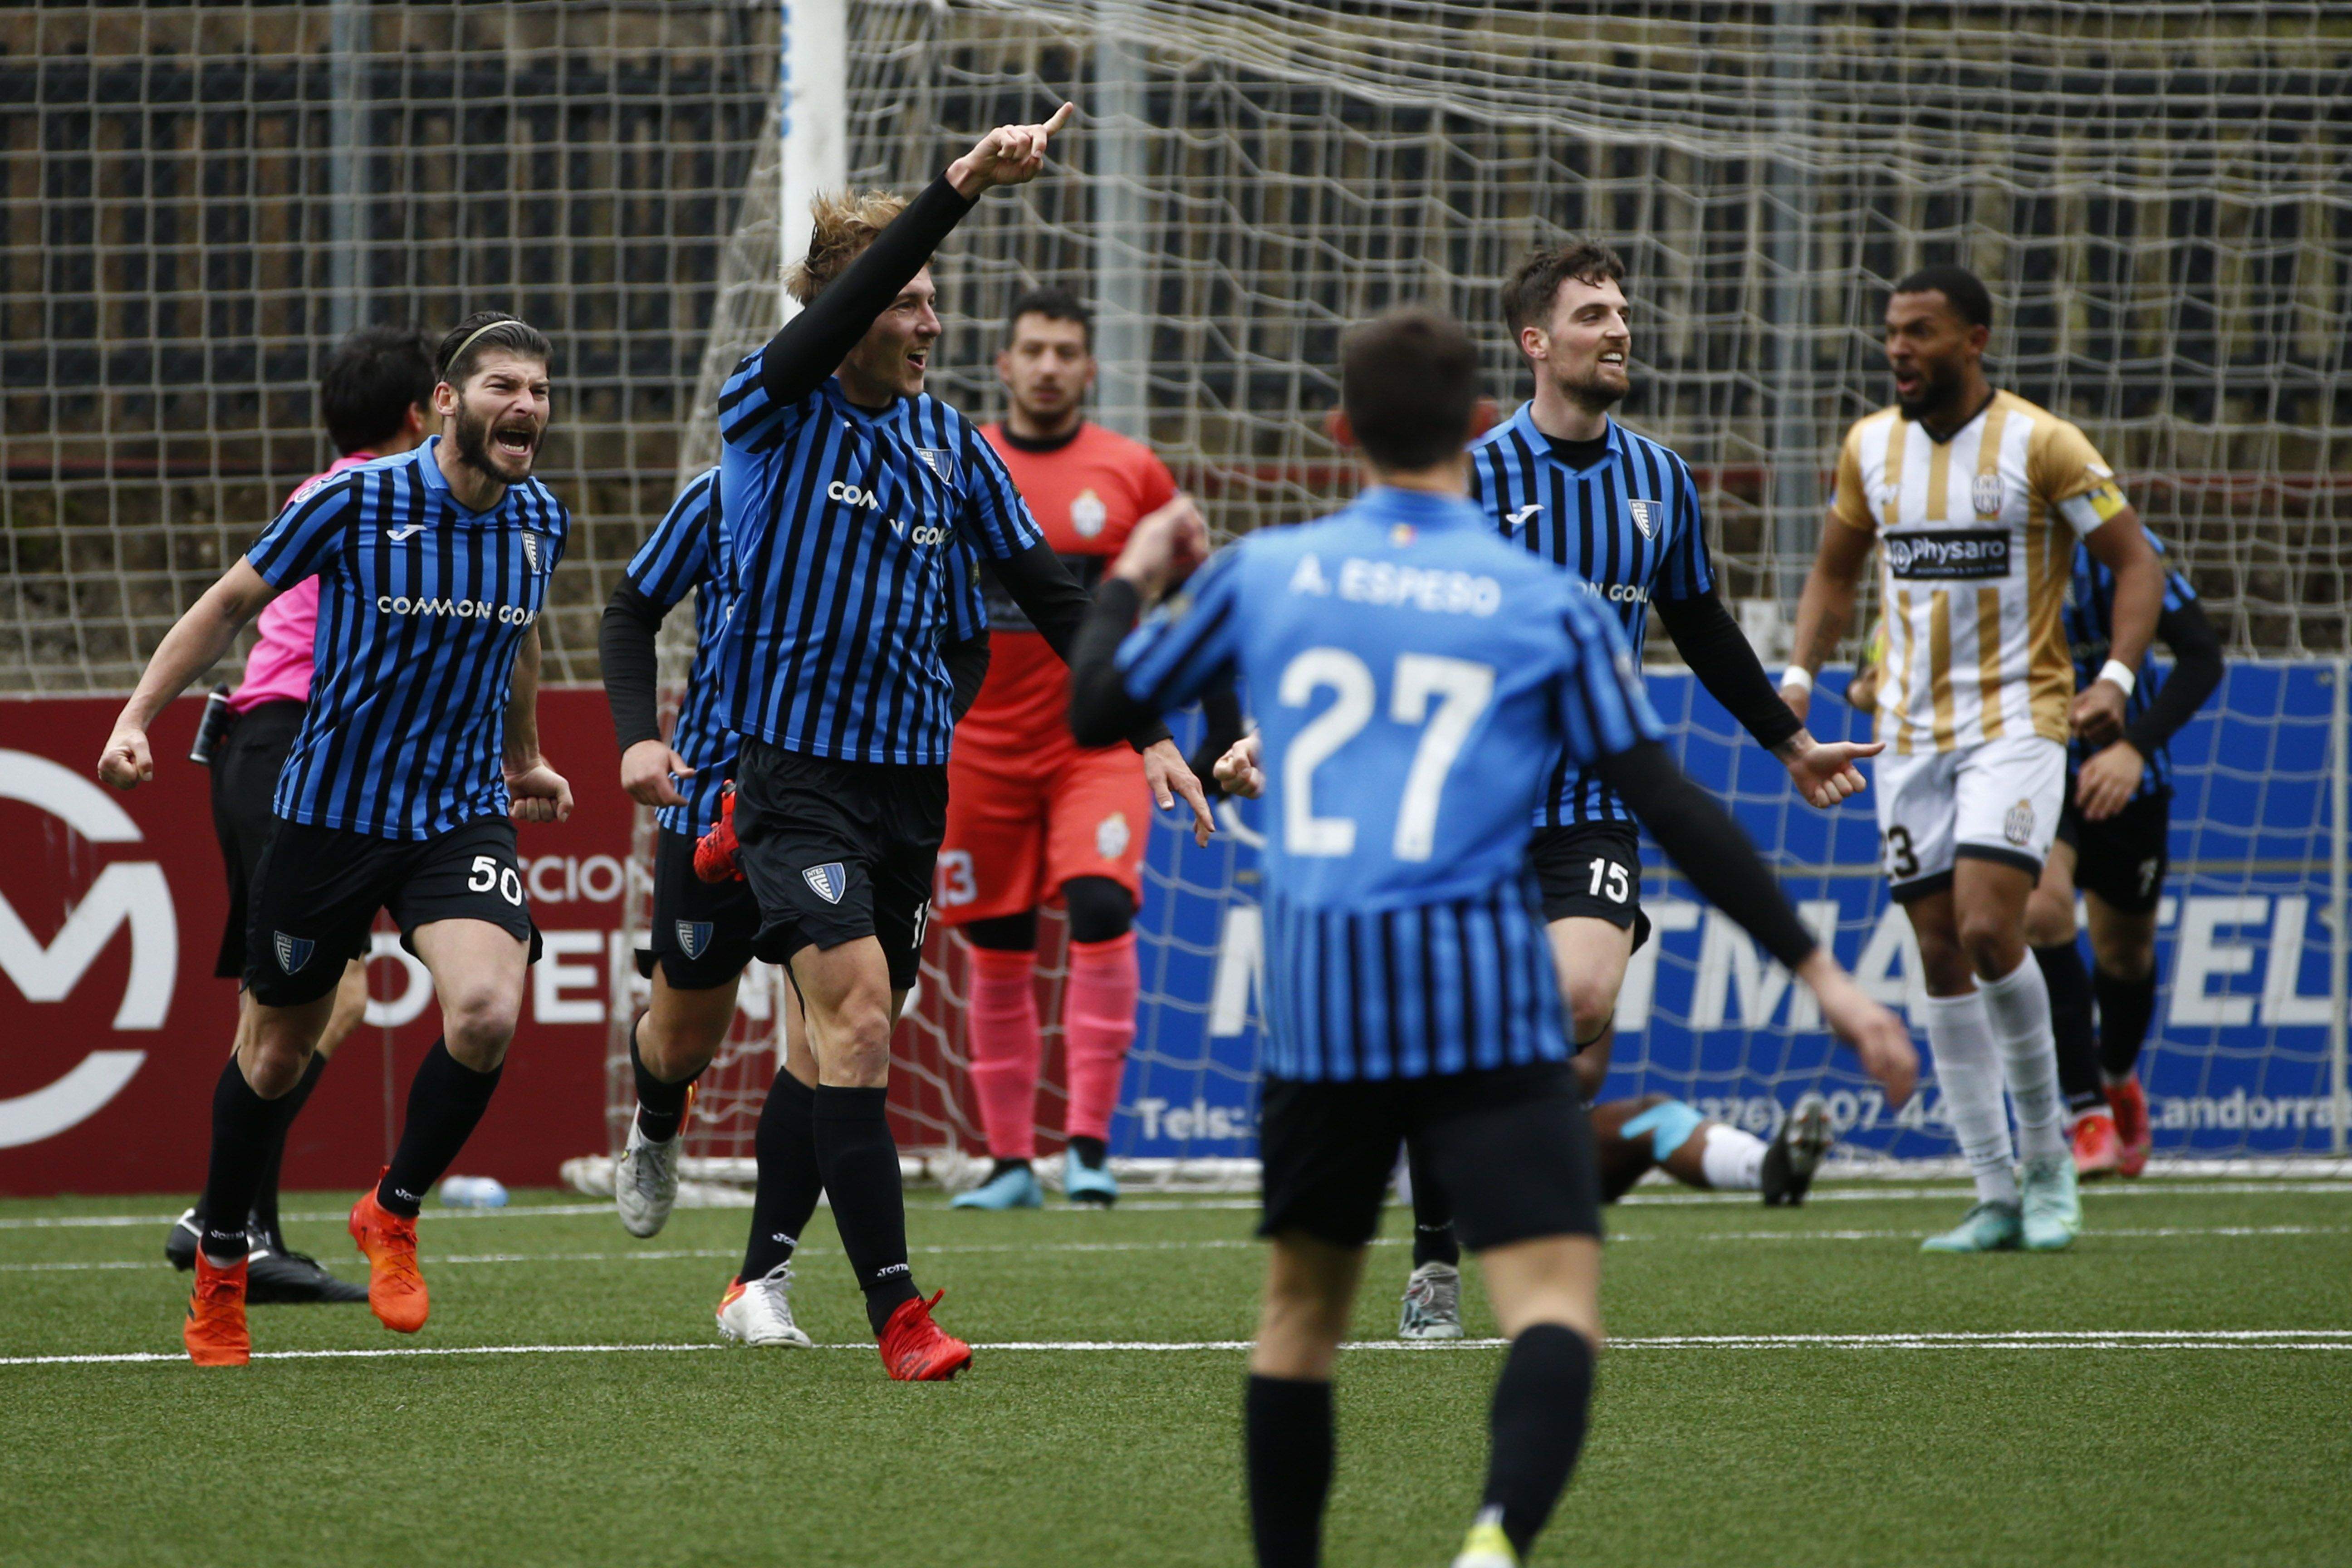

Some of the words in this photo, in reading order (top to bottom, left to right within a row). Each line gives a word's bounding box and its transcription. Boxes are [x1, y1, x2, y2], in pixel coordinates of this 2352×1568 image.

[1911, 536, 2005, 565] Physaro
[1277, 646, 1496, 862] 27
[1881, 825, 1920, 878] 3
[468, 856, 522, 906] 50
[1589, 858, 1629, 904] 15
